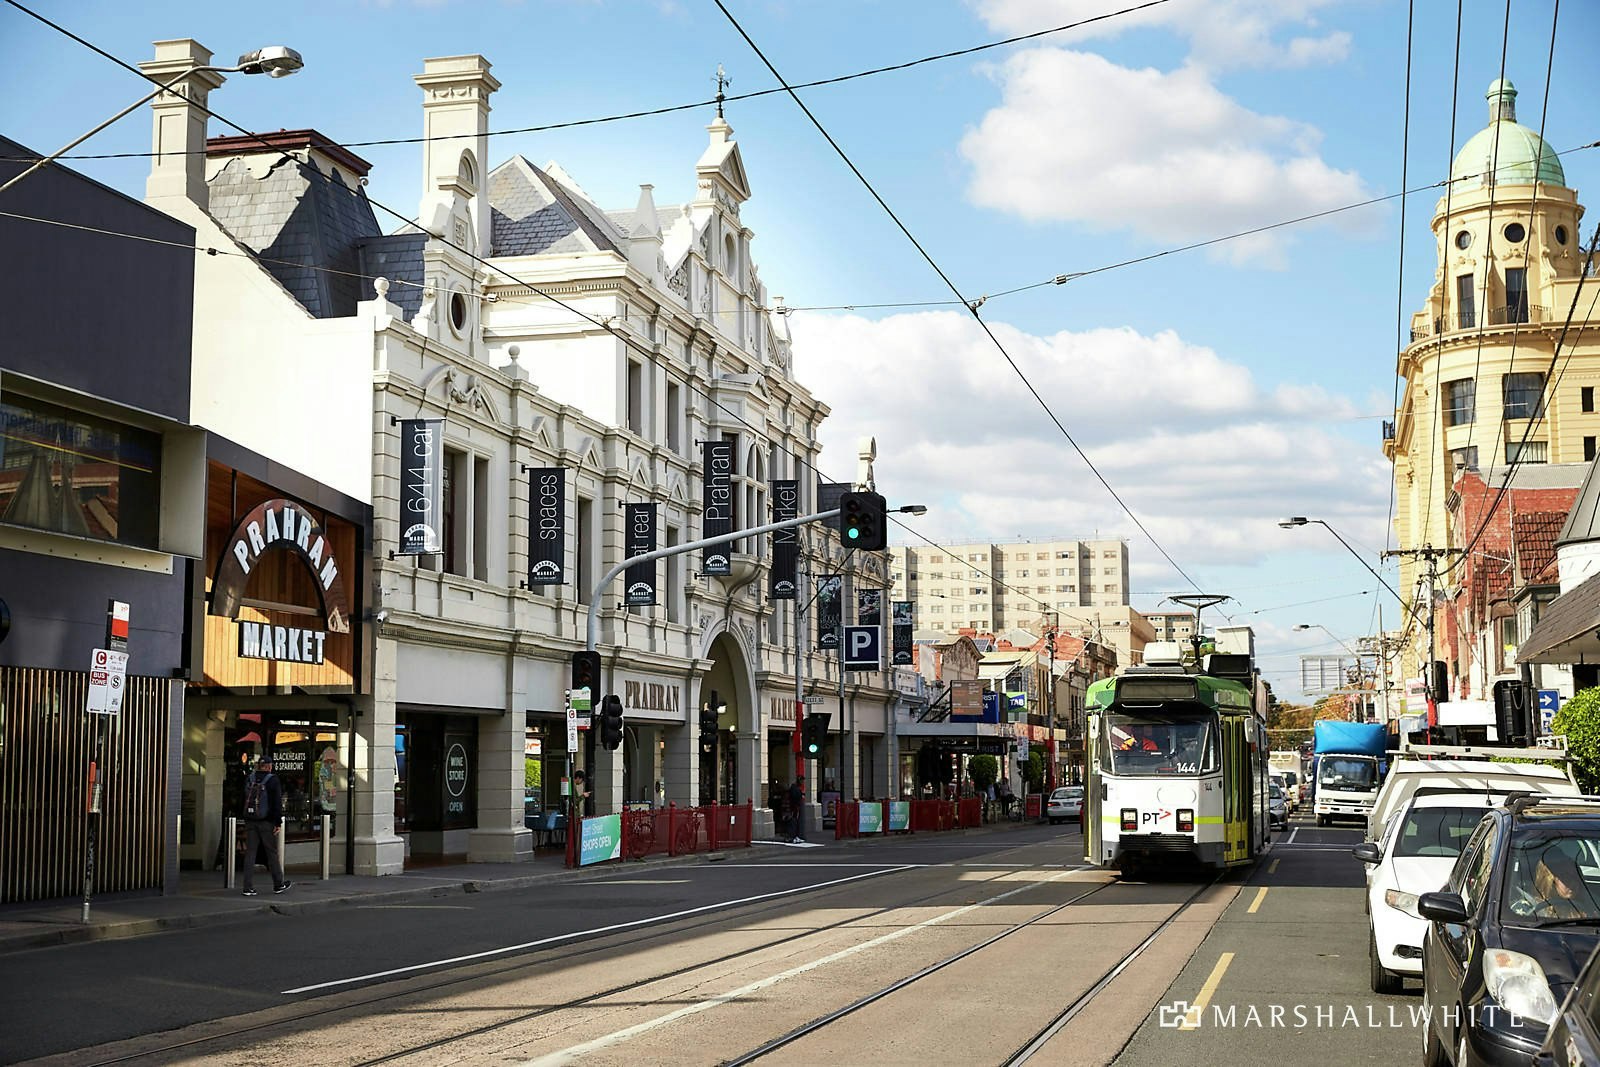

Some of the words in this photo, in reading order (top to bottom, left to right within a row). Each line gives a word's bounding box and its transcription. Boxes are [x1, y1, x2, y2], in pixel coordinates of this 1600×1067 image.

[414, 424, 432, 457] car
[407, 466, 431, 513] 644
[706, 446, 730, 521] Prahran
[540, 474, 560, 540] spaces
[631, 507, 650, 541] rear
[233, 507, 339, 591] PRAHRAN
[242, 622, 325, 664] MARKET
[852, 631, 872, 658] P
[91, 678, 107, 686] ZONE
[624, 679, 679, 713] PRAHRAN
[1010, 698, 1024, 706] TAB
[273, 752, 306, 761] BLACKHEARTS
[279, 762, 304, 771] SPARROWS
[450, 756, 463, 767] WINE
[1177, 762, 1196, 773] 144
[449, 770, 464, 781] STORE
[449, 802, 463, 812] OPEN
[582, 838, 599, 852] SHOPS
[598, 835, 612, 848] OPEN
